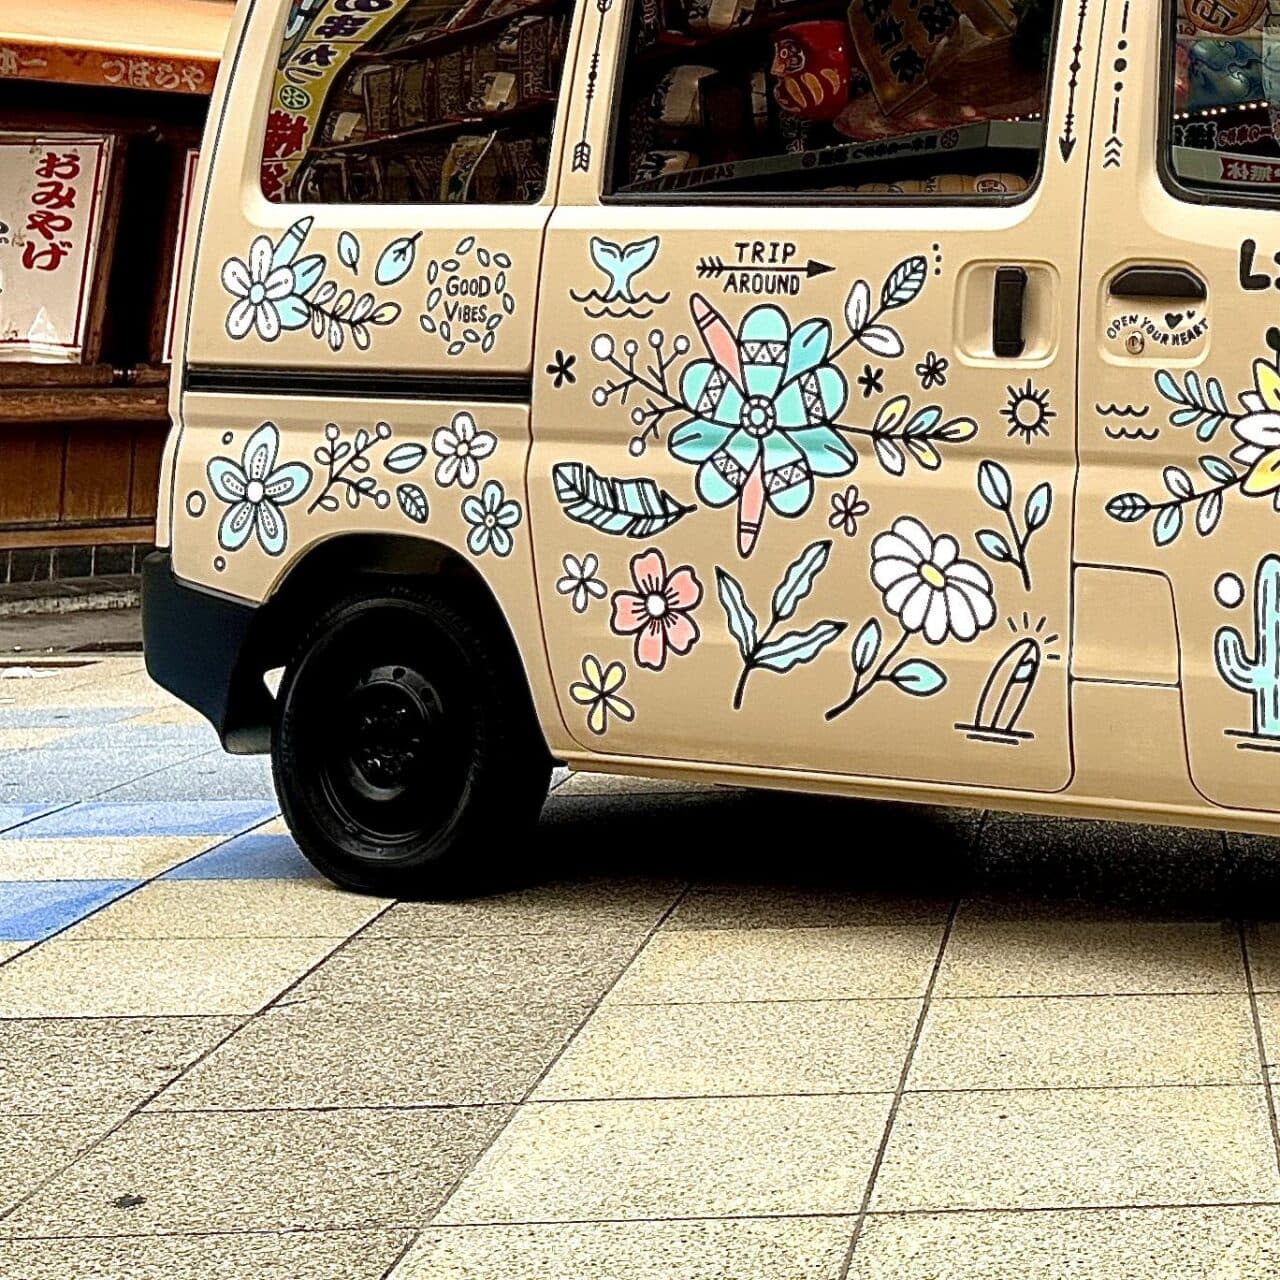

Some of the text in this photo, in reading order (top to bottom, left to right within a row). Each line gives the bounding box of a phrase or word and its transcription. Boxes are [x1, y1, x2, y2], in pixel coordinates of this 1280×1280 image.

[22, 152, 80, 271] おみやげ
[735, 241, 796, 264] TRIP
[446, 275, 491, 298] GOOD
[723, 273, 800, 295] AROUND
[1107, 314, 1209, 345] OPEN YOUR HEART
